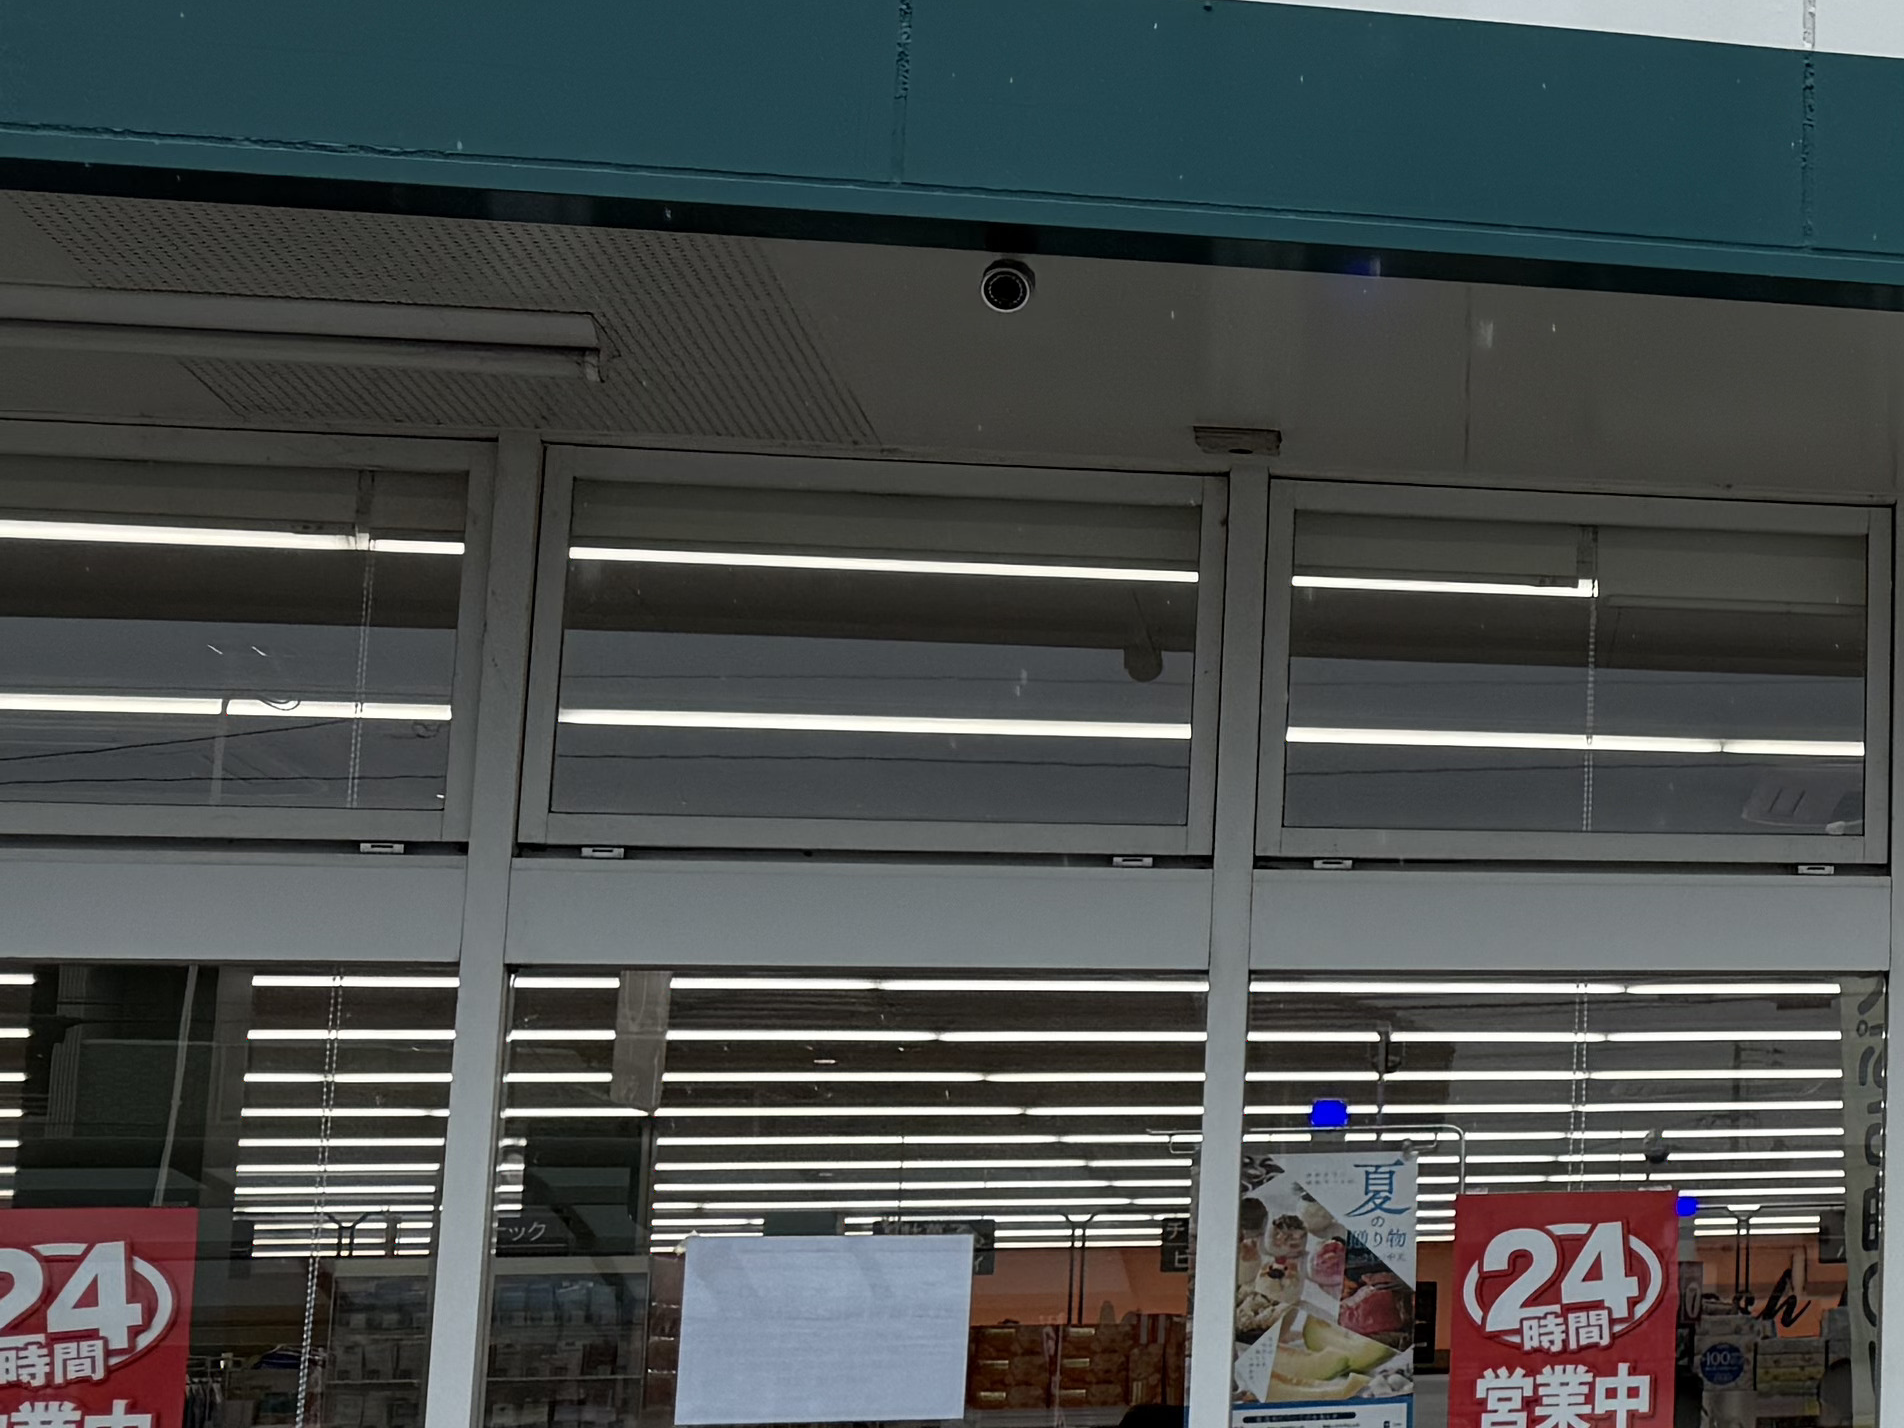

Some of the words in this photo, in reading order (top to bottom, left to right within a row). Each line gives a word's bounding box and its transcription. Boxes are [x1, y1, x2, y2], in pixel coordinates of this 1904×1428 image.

[1346, 1158, 1412, 1217] 夏
[1482, 1221, 1640, 1334] 24
[1520, 1309, 1612, 1351] 時間
[0, 1338, 105, 1387] 時間
